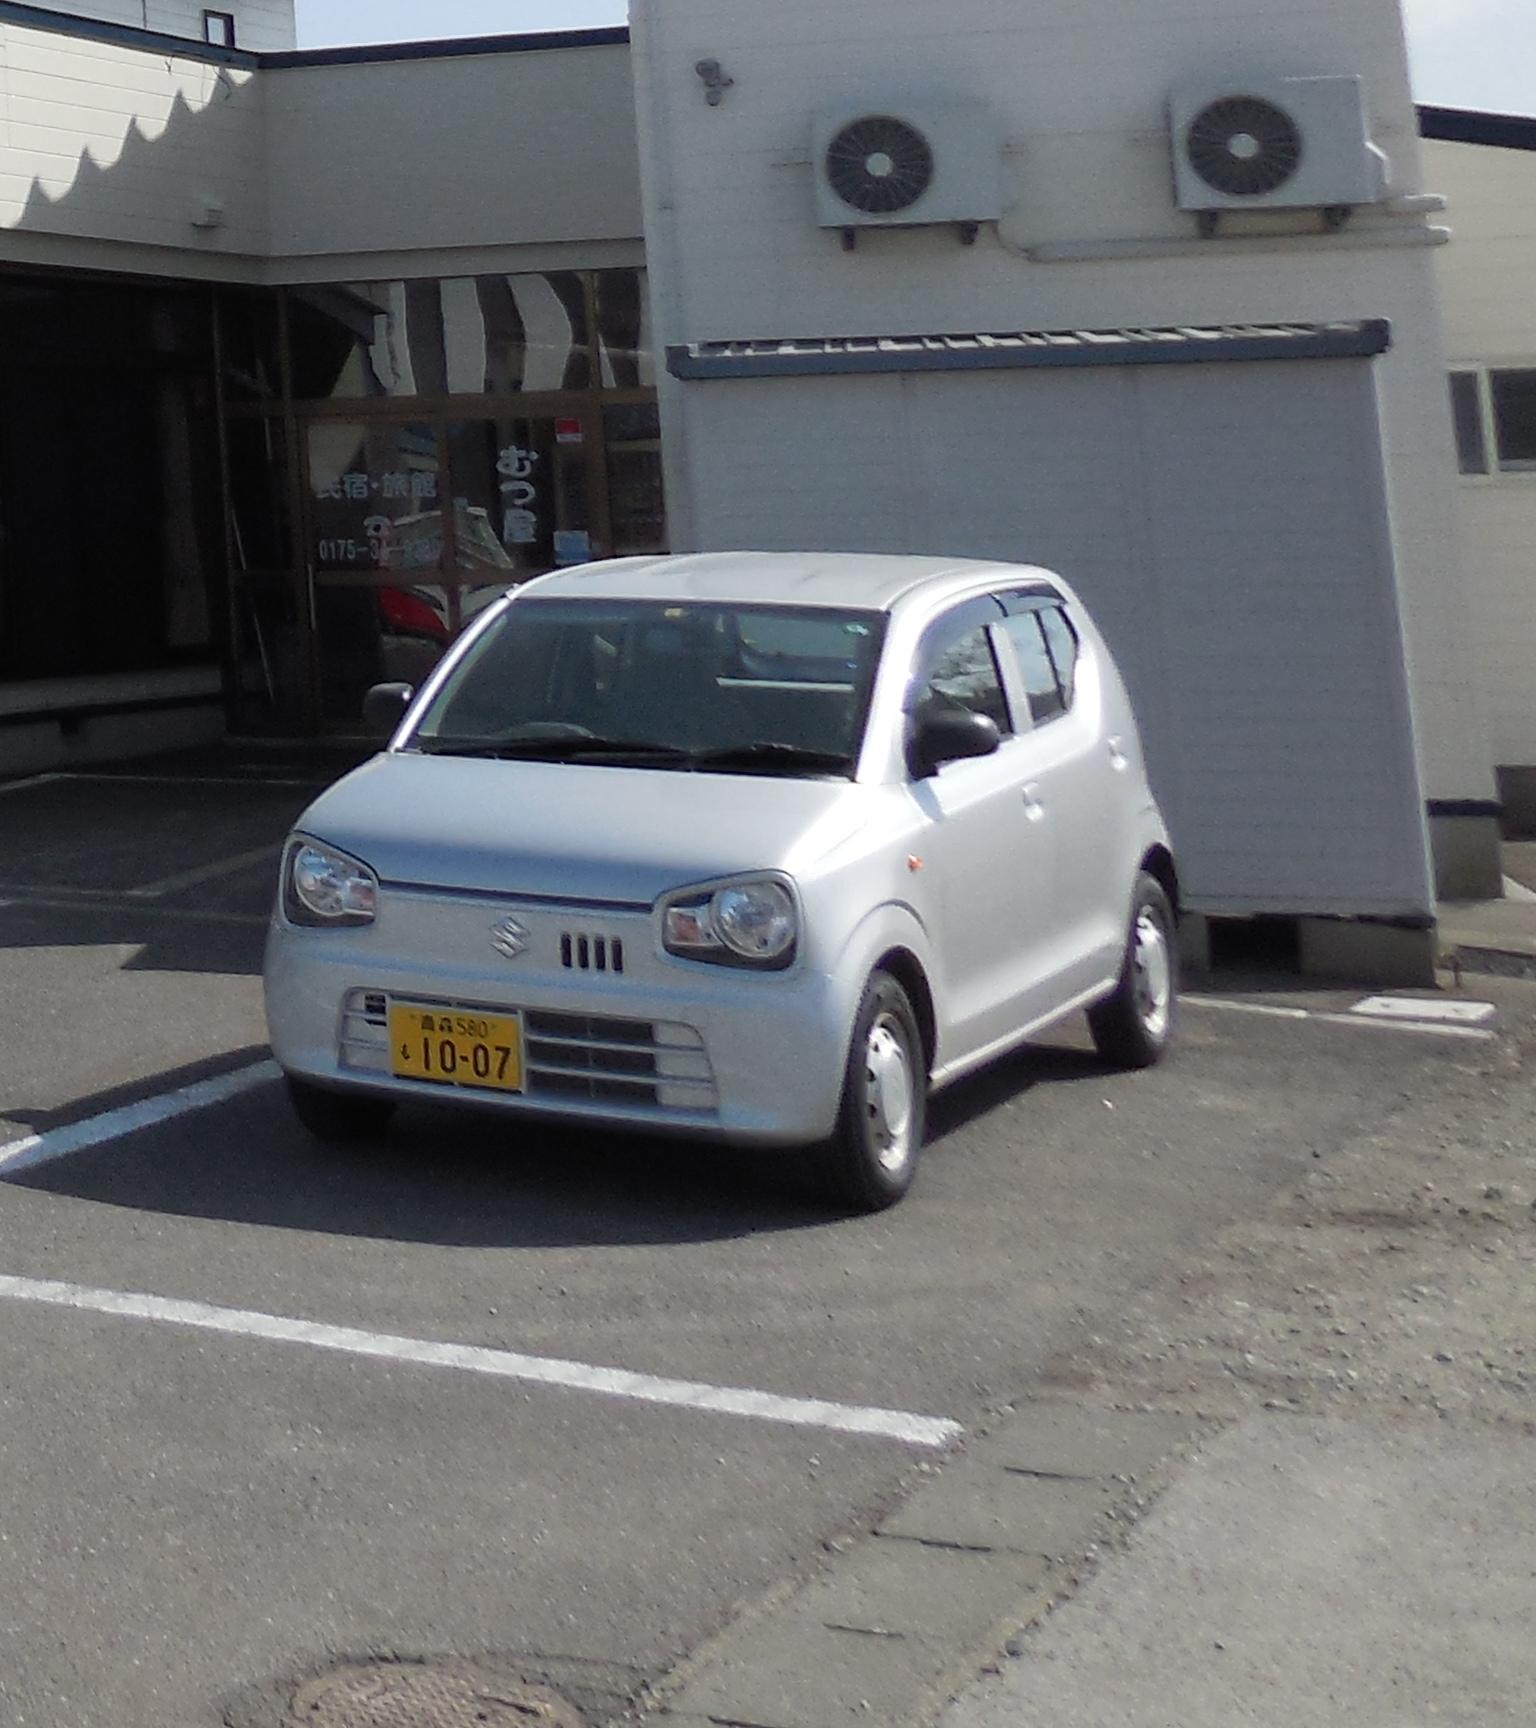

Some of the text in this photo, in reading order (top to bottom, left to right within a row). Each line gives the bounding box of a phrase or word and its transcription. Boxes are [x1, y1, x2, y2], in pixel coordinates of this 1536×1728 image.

[495, 444, 539, 544] むつ屋
[422, 1036, 512, 1081] 10-07
